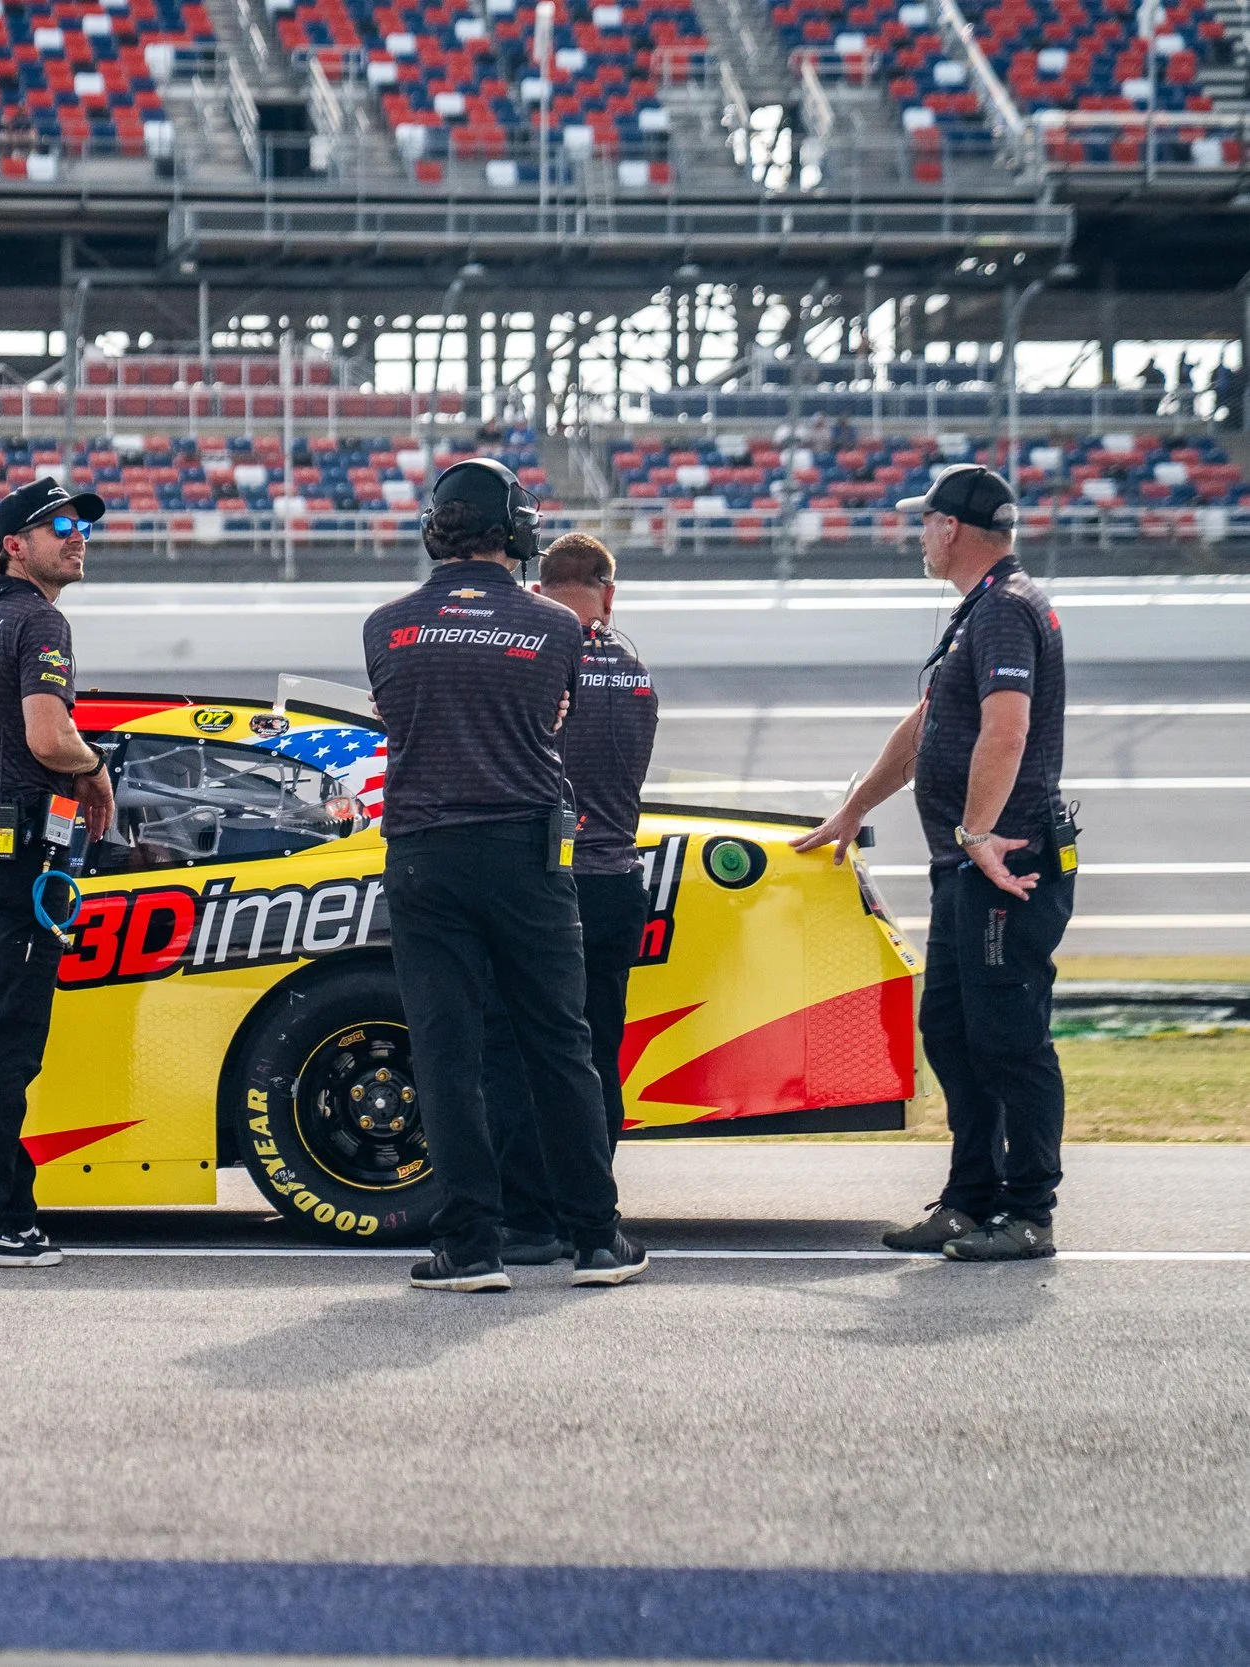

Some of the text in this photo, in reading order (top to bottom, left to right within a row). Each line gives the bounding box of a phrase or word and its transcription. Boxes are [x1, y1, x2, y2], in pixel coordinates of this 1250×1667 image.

[445, 608, 494, 616] PETERSON
[388, 625, 548, 651] 3Dimensional
[997, 667, 1030, 679] NASCAR
[579, 672, 651, 689] mensional
[197, 712, 230, 724] 07
[247, 1088, 379, 1236] GOODYEAR
